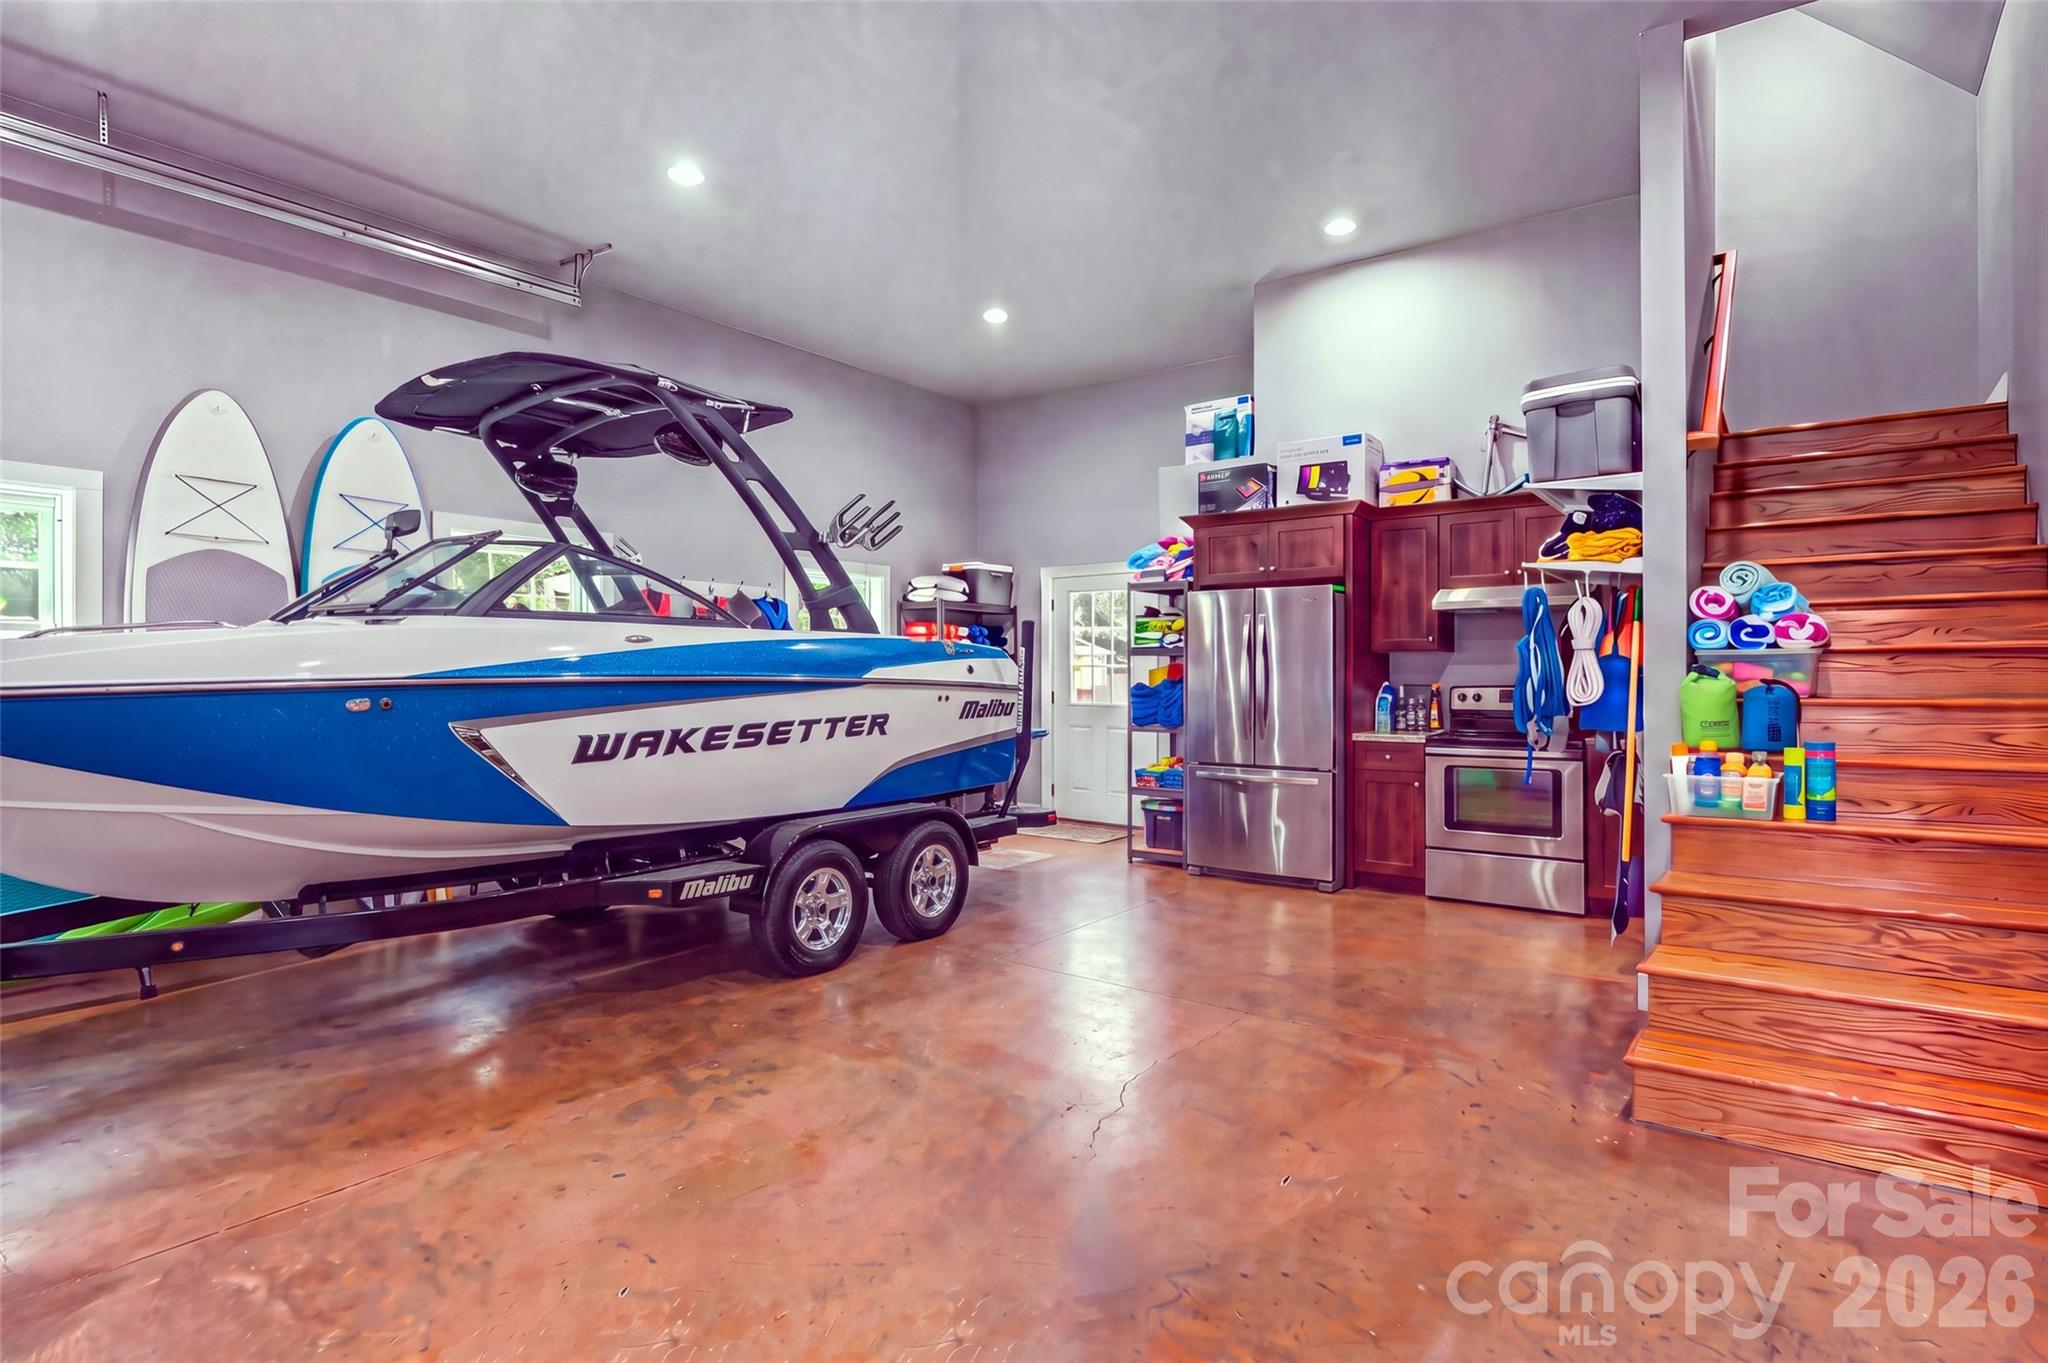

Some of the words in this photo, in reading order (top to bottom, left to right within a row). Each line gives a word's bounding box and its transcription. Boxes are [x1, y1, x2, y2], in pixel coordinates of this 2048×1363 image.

[958, 699, 1016, 720] Malibu
[571, 712, 890, 764] WAKESETTER
[680, 873, 754, 901] Malibu
